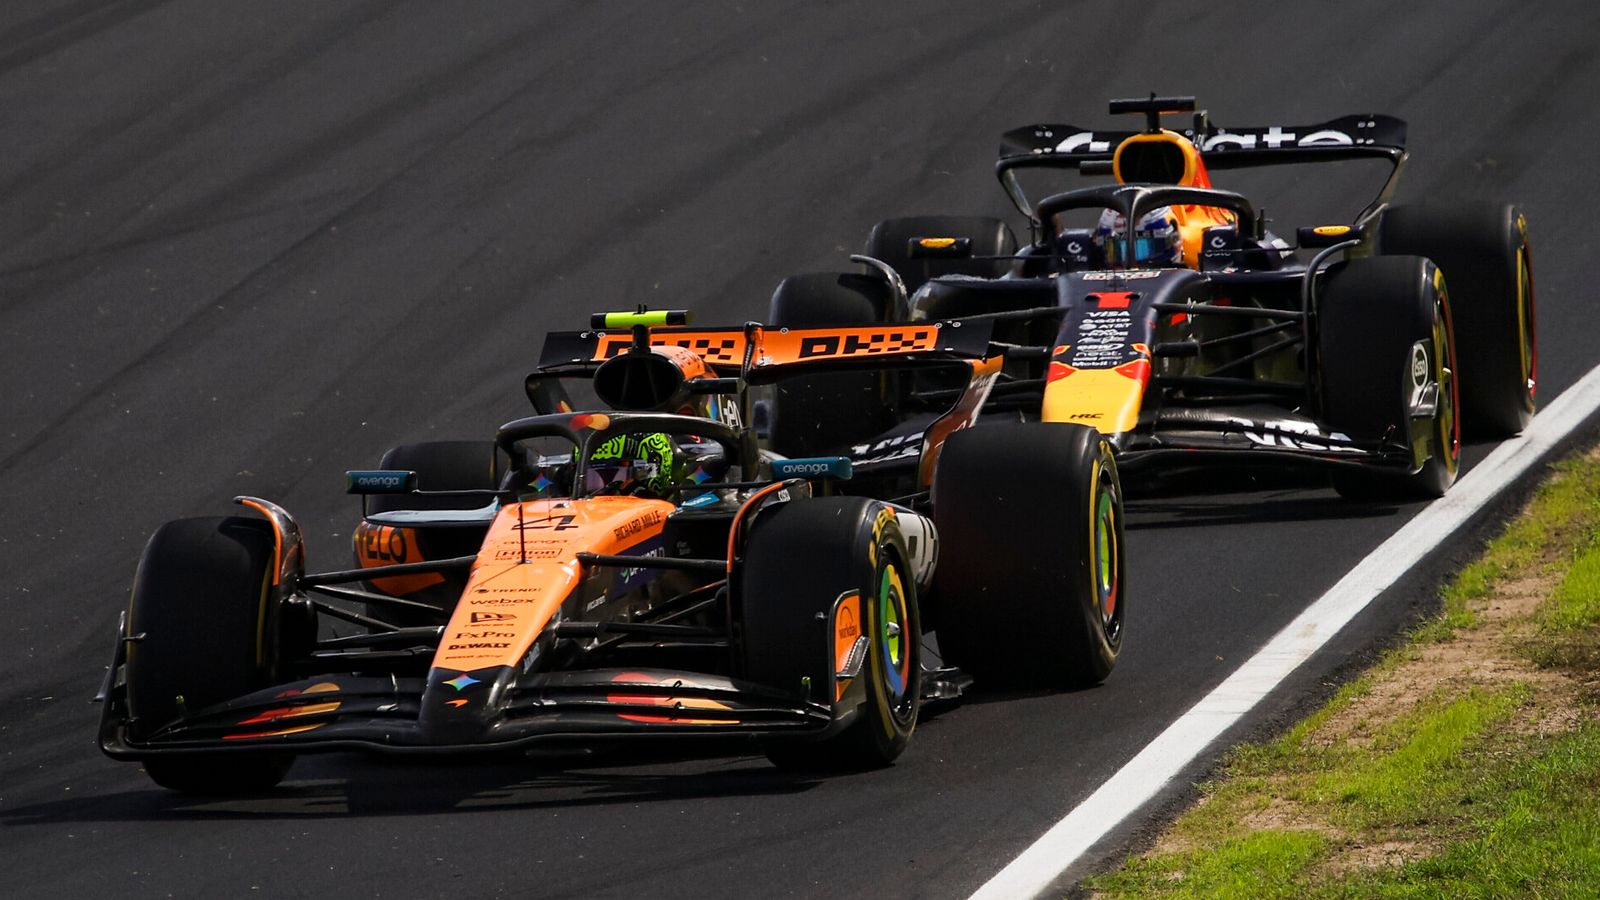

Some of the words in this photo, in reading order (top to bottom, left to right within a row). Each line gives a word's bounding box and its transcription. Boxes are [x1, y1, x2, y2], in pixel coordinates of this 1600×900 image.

[604, 340, 735, 360] OX
[799, 332, 928, 358] OKX
[783, 463, 829, 474] avenga
[358, 477, 400, 487] avenga
[511, 515, 579, 531] 4
[614, 518, 642, 543] RICHARD
[641, 510, 661, 528] MILLE
[456, 631, 516, 639] FxPro
